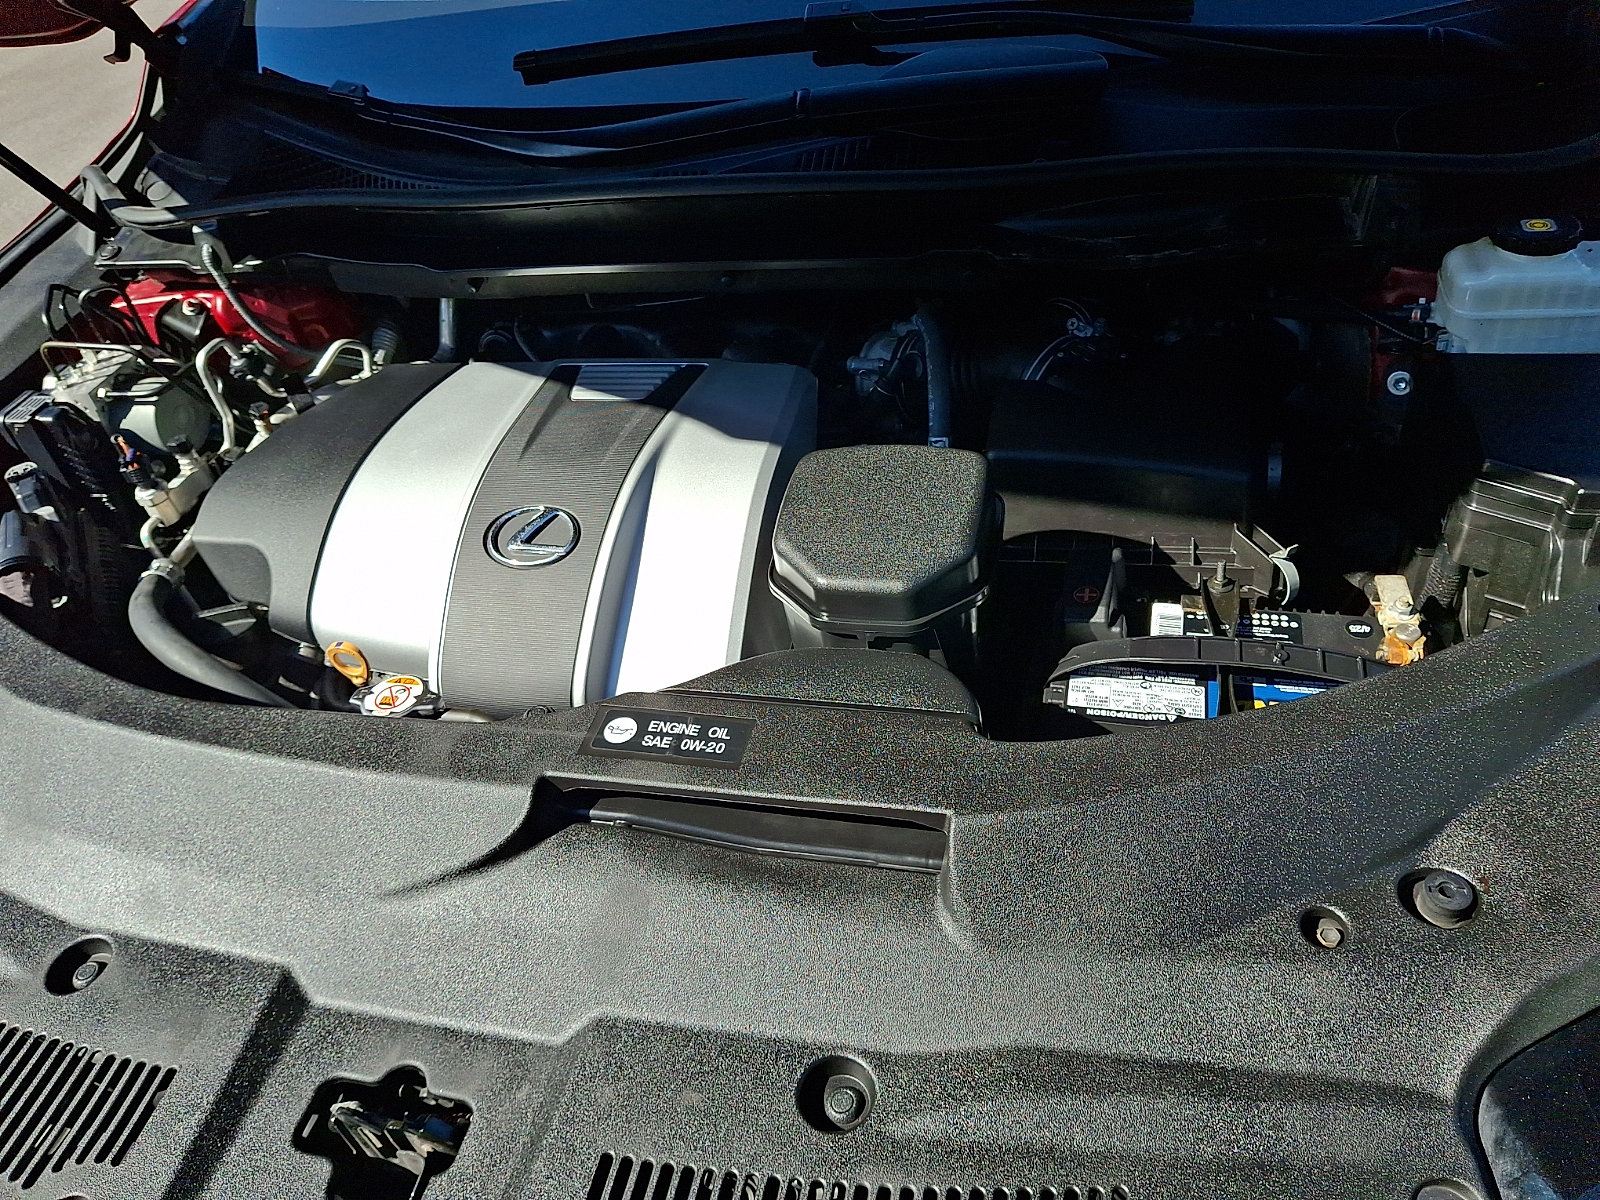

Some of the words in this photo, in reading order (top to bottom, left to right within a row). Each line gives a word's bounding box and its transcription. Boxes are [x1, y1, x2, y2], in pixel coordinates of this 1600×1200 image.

[647, 720, 701, 737] ENGINE
[708, 726, 731, 740] OIL
[641, 735, 671, 748] SAE
[680, 738, 726, 754] 0W-20
